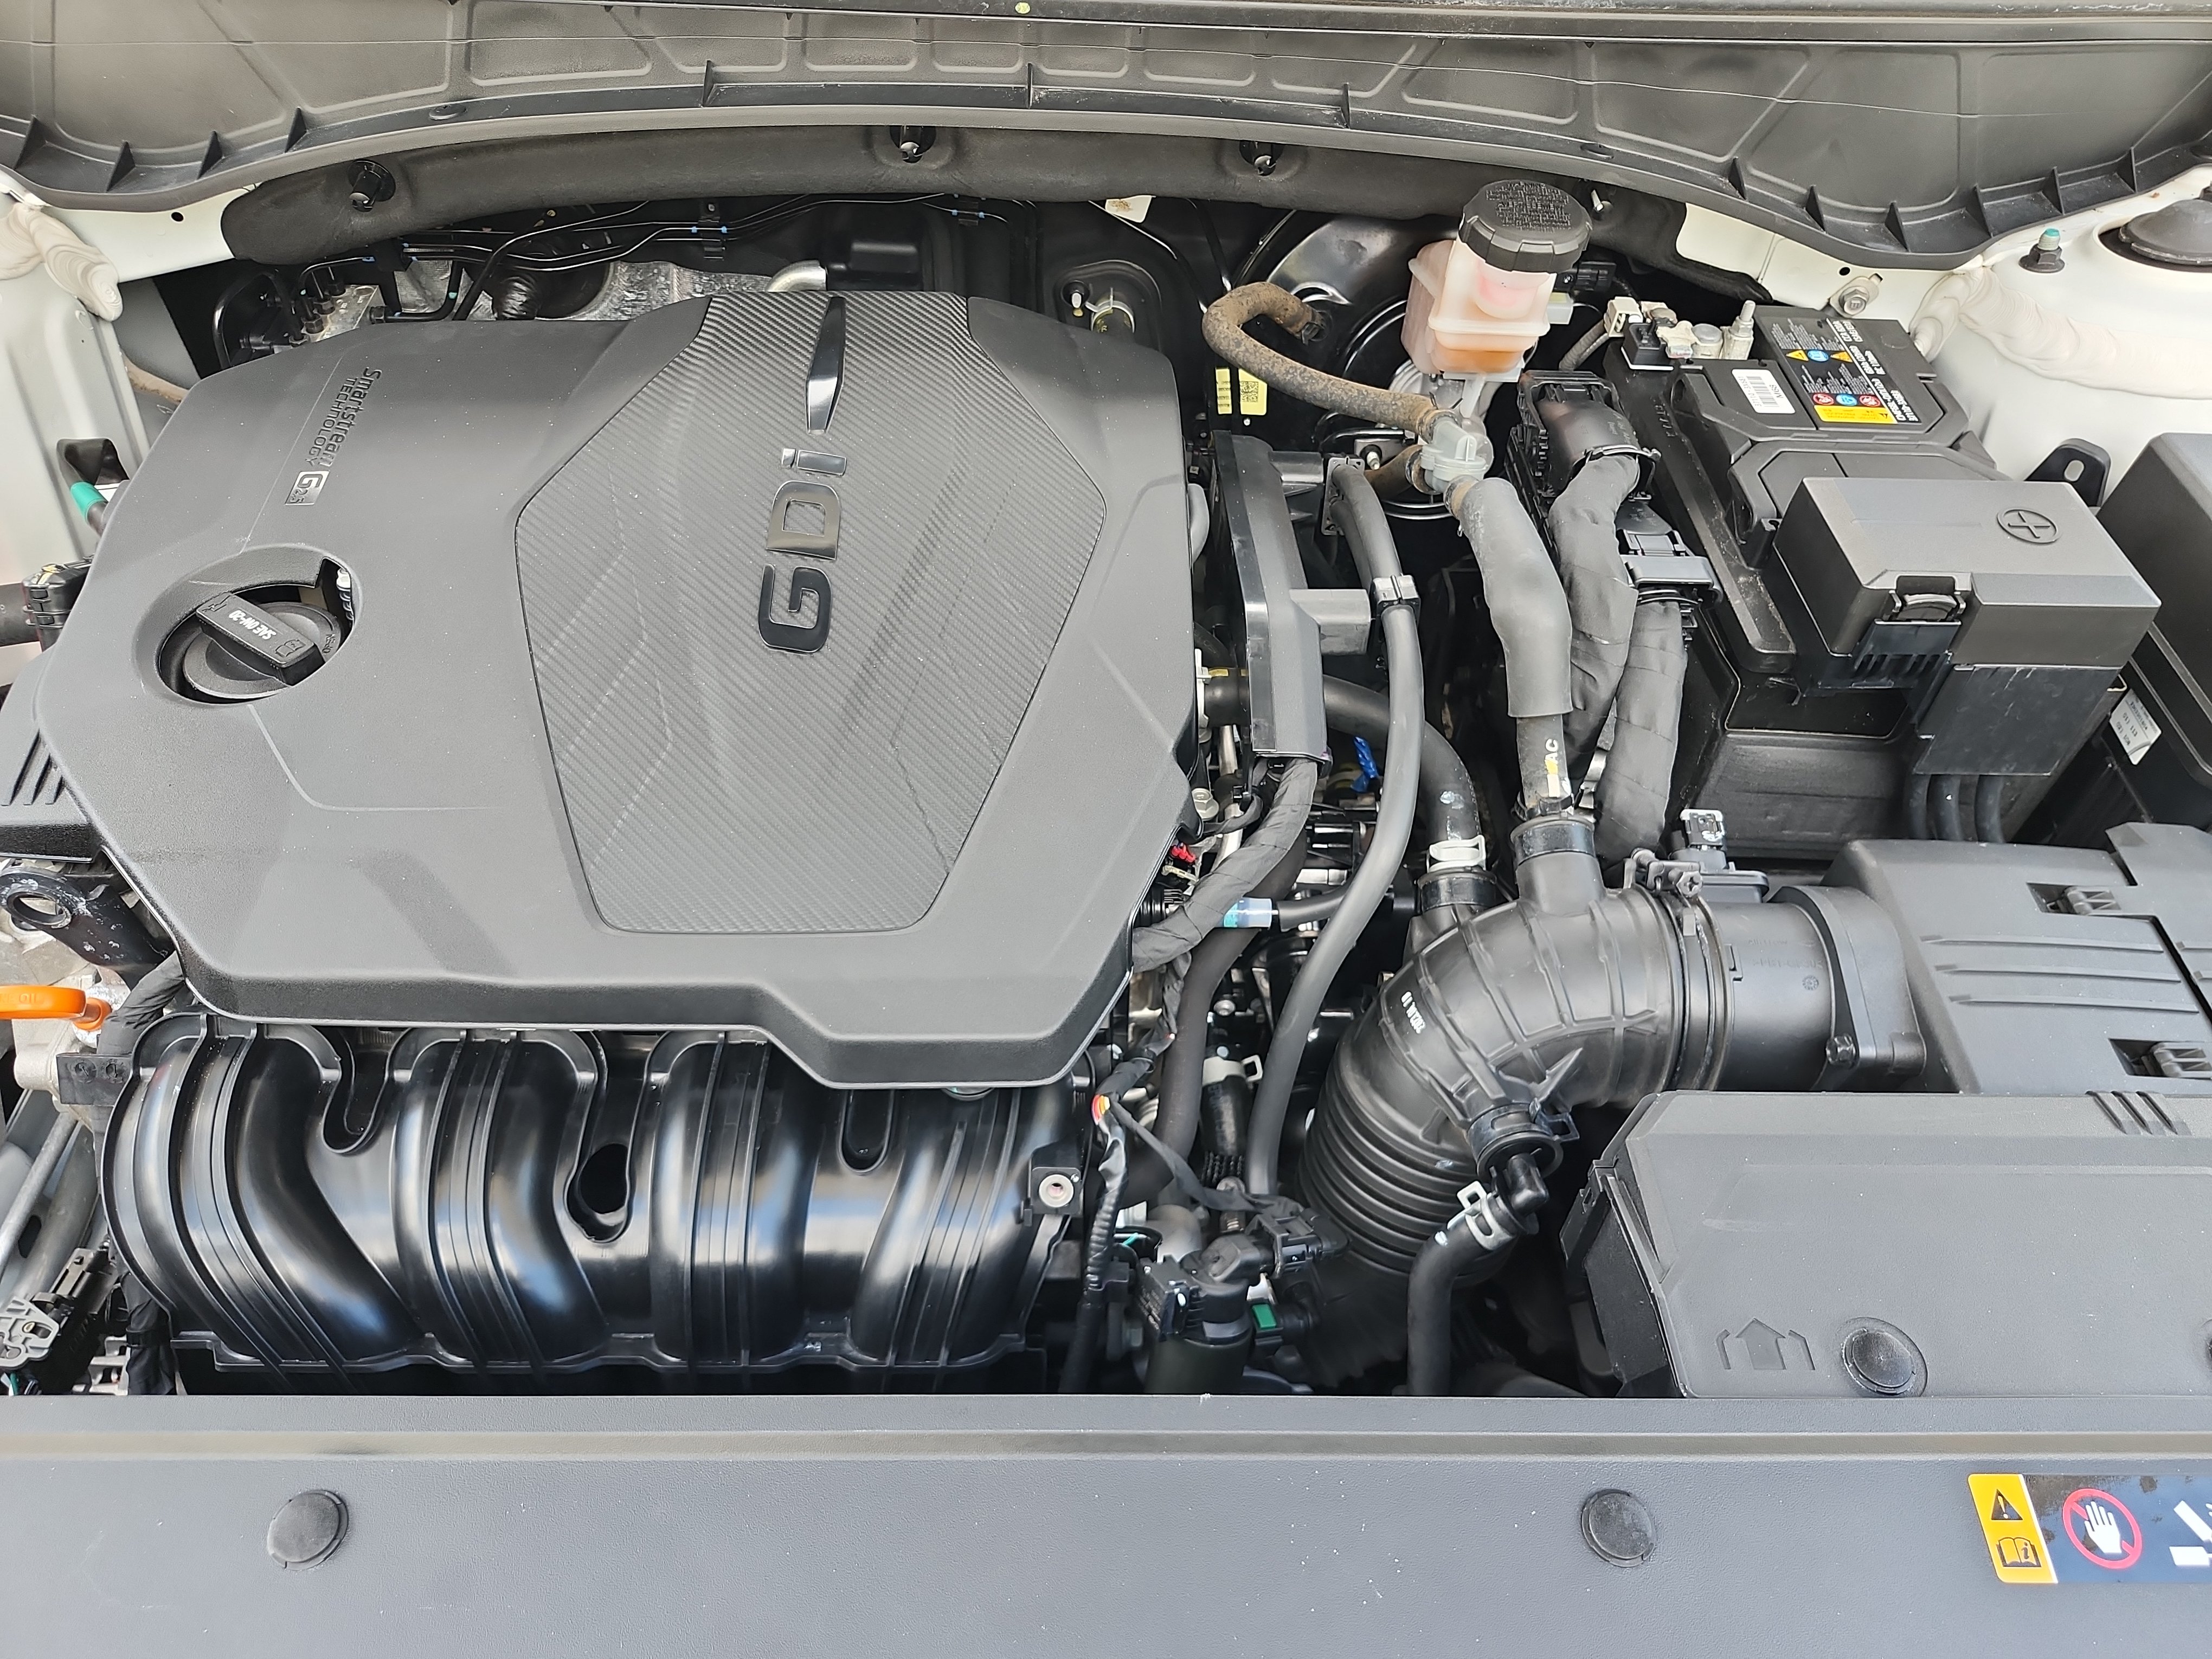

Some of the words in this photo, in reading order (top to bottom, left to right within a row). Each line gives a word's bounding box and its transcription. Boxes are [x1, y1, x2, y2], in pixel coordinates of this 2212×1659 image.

[305, 377, 358, 466] TECHNOLOGY
[318, 366, 382, 467] Smartstream
[757, 448, 847, 653] GDi
[228, 610, 260, 629] 0W-20
[252, 625, 277, 640] SAE
[321, 634, 336, 654] OPEN
